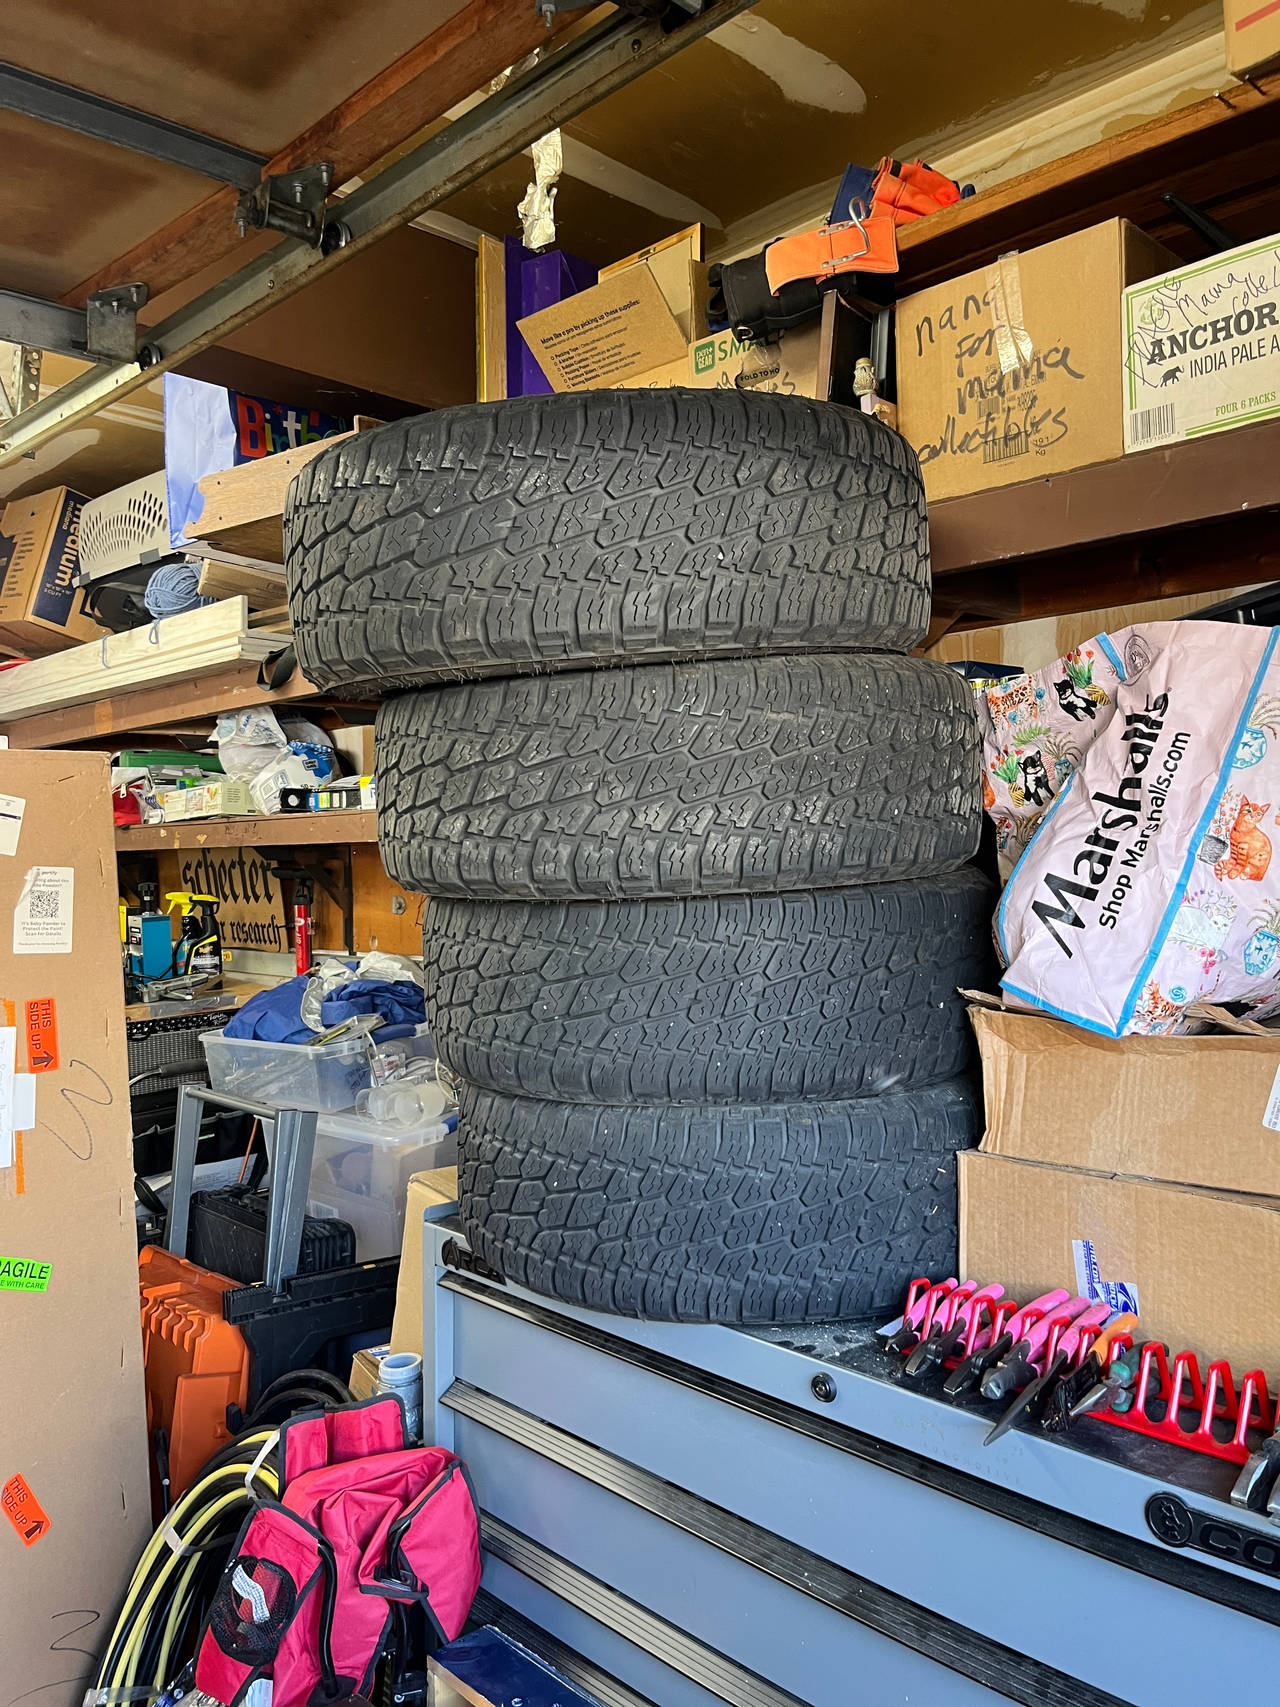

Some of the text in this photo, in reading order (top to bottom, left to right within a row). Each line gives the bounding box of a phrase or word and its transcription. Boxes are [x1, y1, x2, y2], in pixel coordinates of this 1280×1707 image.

[1147, 302, 1279, 366] ANCHOR
[1189, 350, 1228, 378] INDIA
[1231, 337, 1267, 366] PALE
[740, 372, 758, 382] FOLD
[759, 370, 769, 378] TO
[1215, 403, 1238, 416] FOUR
[1248, 391, 1277, 407] PACKS
[1032, 692, 1169, 959] Marshalls
[1099, 732, 1191, 930] Shop Marshalls.com
[230, 914, 281, 952] research
[30, 1002, 41, 1050] SIDE UP
[41, 1000, 51, 1028] THIS
[0, 1260, 50, 1279] AGILE
[6, 1280, 25, 1288] WITH
[10, 1477, 28, 1503] THIS
[14, 1510, 28, 1525] UP
